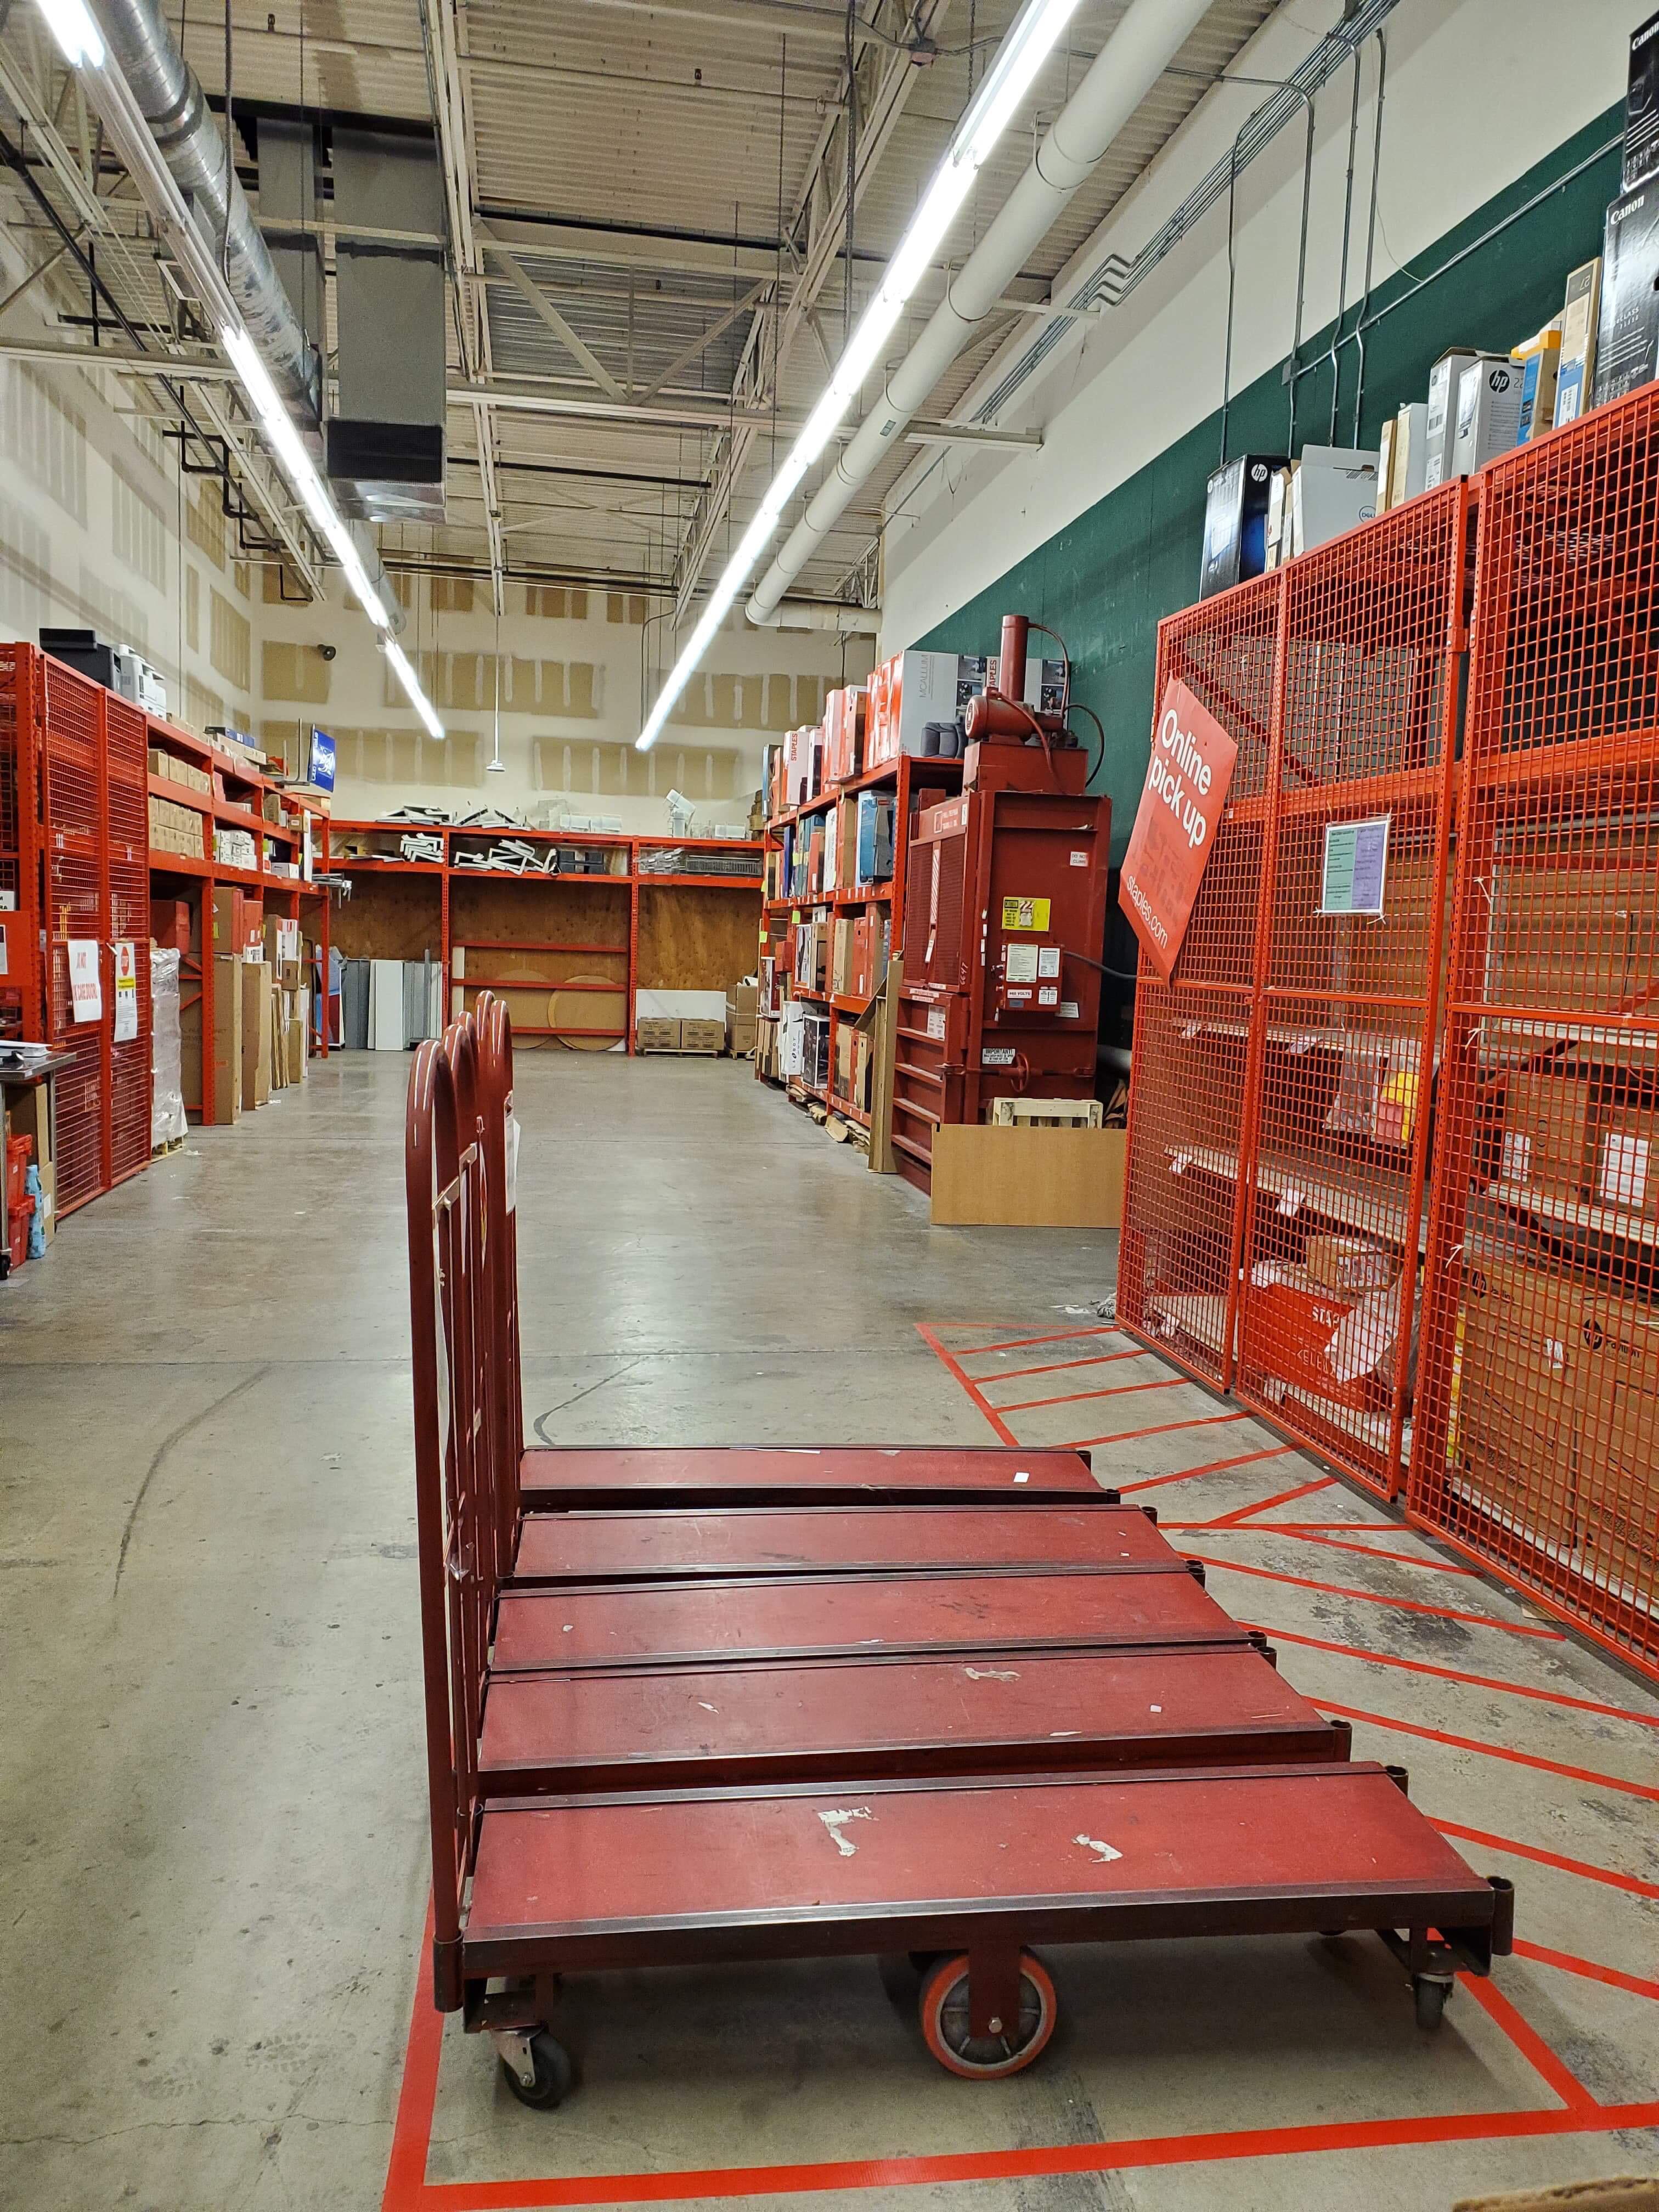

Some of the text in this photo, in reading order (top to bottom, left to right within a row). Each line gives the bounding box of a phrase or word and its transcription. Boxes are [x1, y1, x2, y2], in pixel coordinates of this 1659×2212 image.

[1632, 20, 1659, 51] Canon
[1610, 195, 1645, 225] Canon
[1489, 370, 1510, 393] hp
[1252, 464, 1267, 482] hp
[919, 654, 929, 698] MCALLUM
[989, 659, 997, 687] APLES
[1161, 709, 1211, 795] Online
[1148, 755, 1206, 849] pick up
[1126, 873, 1169, 949] staples.com
